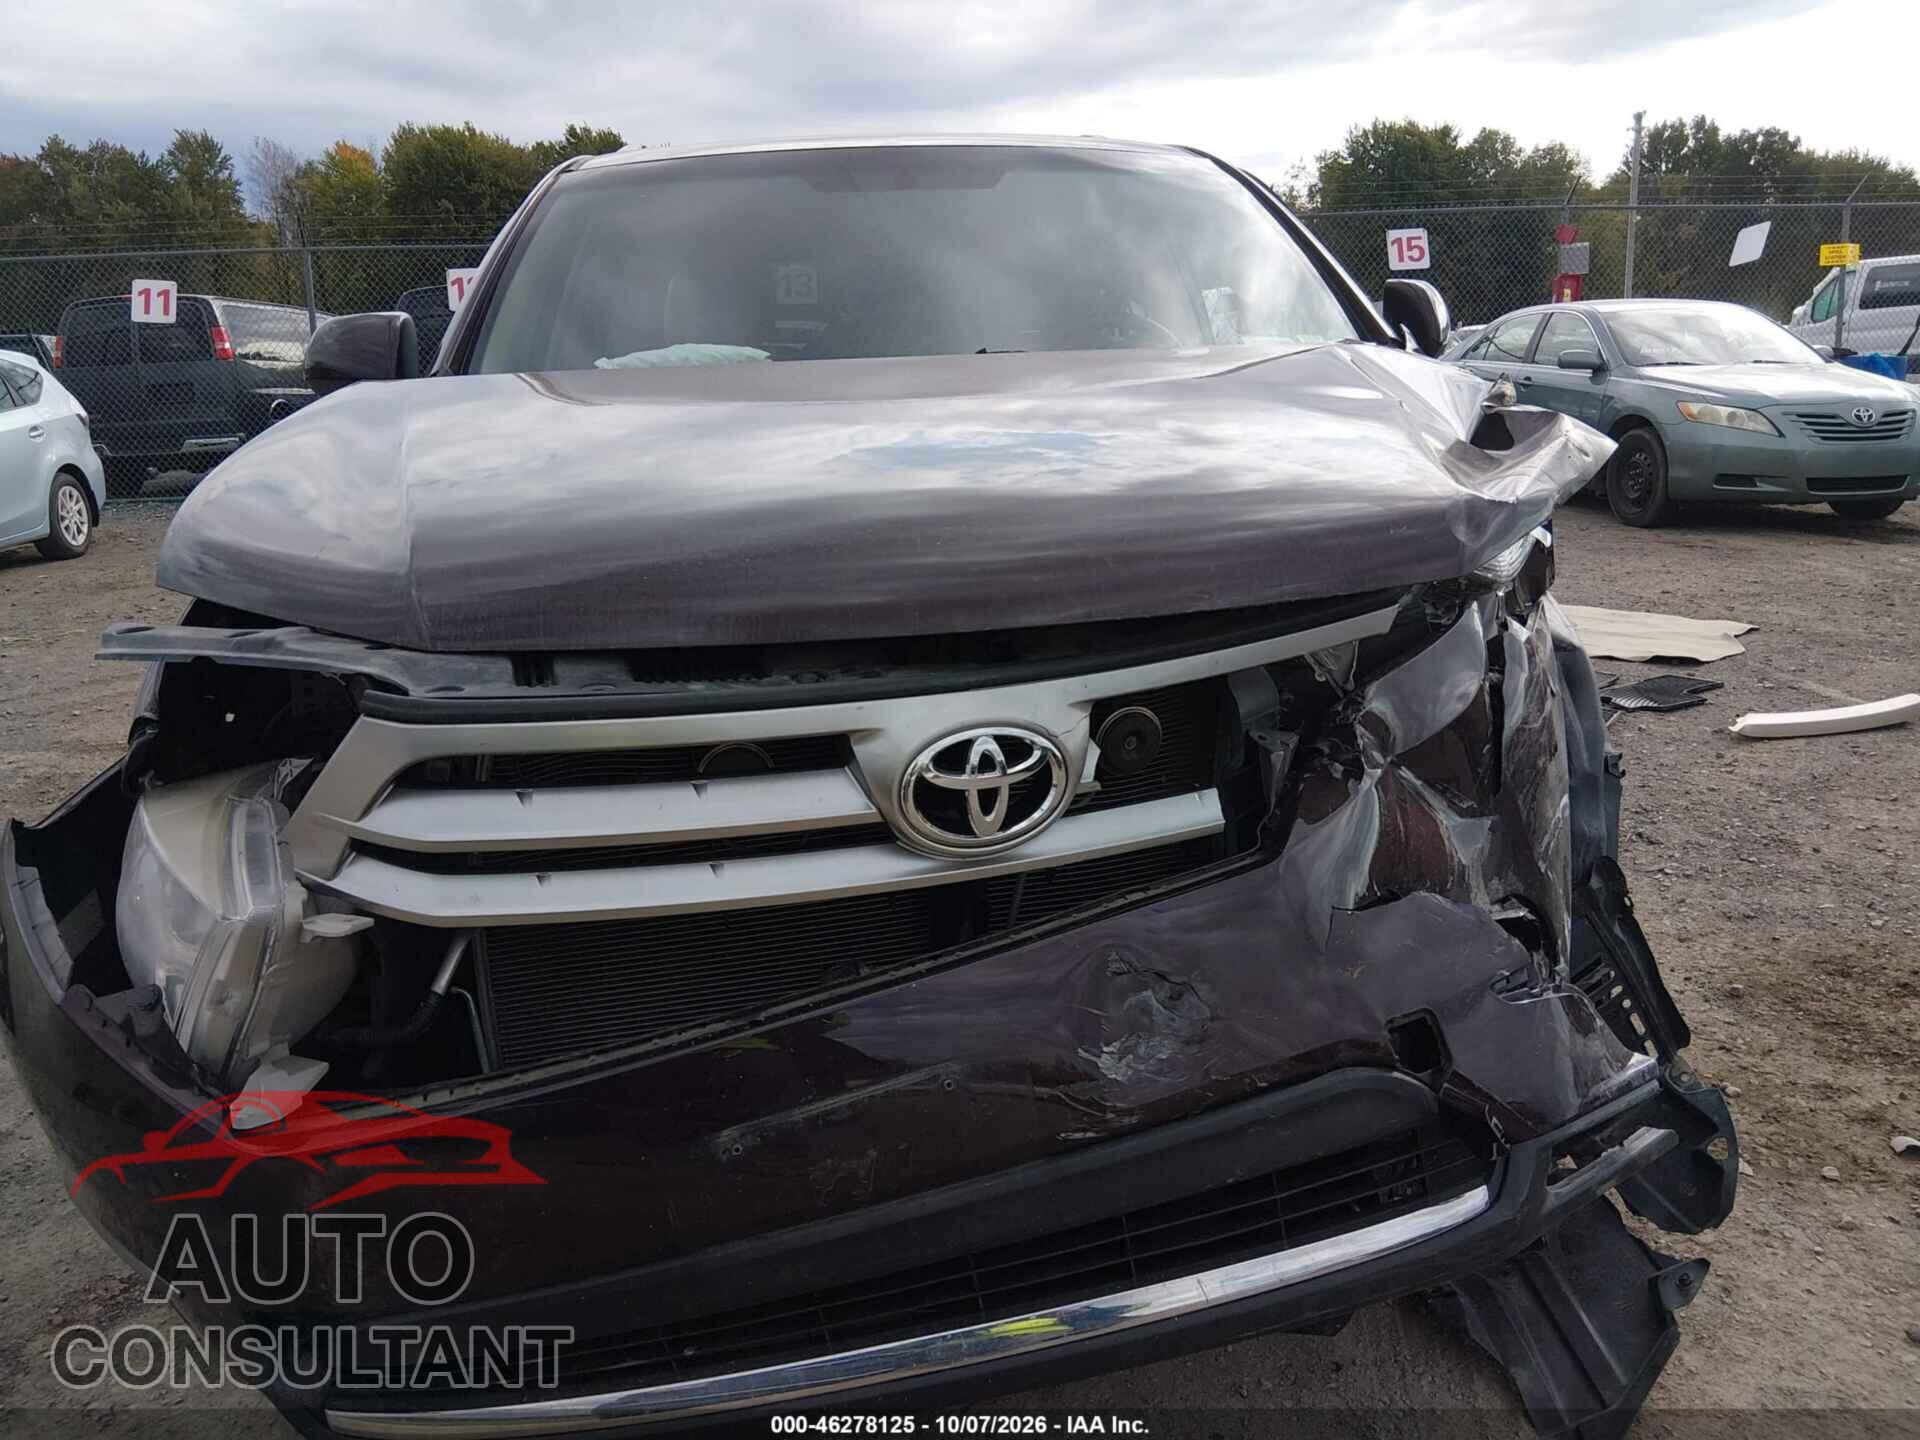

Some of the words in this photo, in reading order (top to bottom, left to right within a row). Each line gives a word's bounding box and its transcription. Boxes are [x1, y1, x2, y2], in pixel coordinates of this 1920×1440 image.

[1391, 236, 1425, 263] 15
[137, 287, 170, 316] 11
[450, 277, 474, 304] 1
